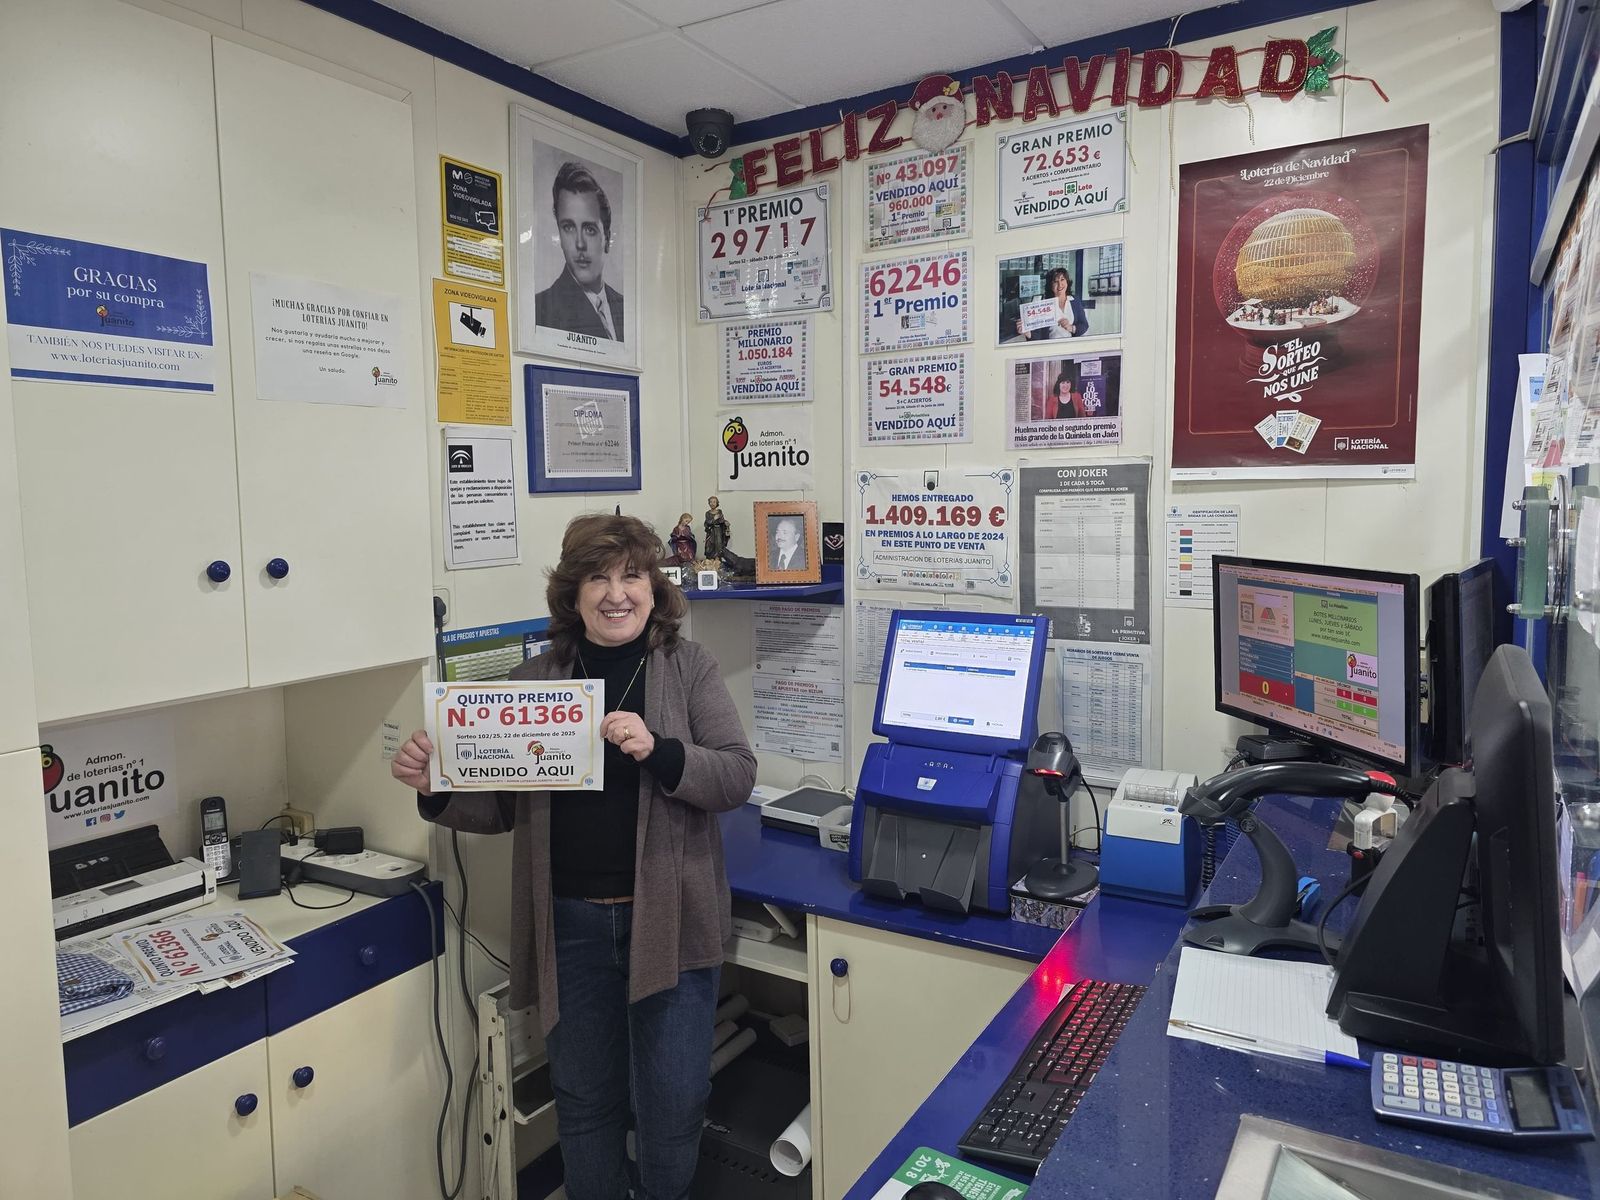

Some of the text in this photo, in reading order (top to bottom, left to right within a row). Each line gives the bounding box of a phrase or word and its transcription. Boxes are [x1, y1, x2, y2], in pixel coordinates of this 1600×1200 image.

[742, 39, 1309, 196] FELIZ NAVIDAD
[1011, 123, 1113, 154] GRAN PREMIO
[1023, 145, 1089, 173] 72.653
[1240, 149, 1357, 181] Lotería de Navidad
[895, 155, 958, 182] 43.097
[1026, 172, 1049, 181] ACIERTOS
[1054, 162, 1101, 176] COMPLEMENTARIO
[1263, 170, 1329, 187] 22 de Diciembre
[452, 184, 468, 193] ZONA
[876, 174, 959, 202] VENDIDO AQUÍ
[453, 191, 492, 208] VIDEOVIGILADA
[889, 195, 933, 213] 960.000
[1014, 198, 1070, 216] VENDIDO
[1074, 187, 1108, 206] AQUÍ
[737, 197, 803, 225] PREMIO
[901, 210, 925, 220] Premio
[74, 266, 157, 293] GRACIAS
[869, 258, 961, 297] 62246
[66, 286, 165, 309] por su compra
[444, 288, 497, 303] ZONA VIDEOVIGILADA
[894, 292, 959, 315] Premio
[272, 298, 389, 322] ¡MUCHAS GRACIAS POR CONFIAR EN
[302, 313, 368, 330] LOTERÍAS JUANITO!
[566, 333, 597, 346] JUANITO
[747, 327, 782, 338] PREMIO
[27, 334, 203, 360] TAMBIÉN NOS PUEDES VISITAR EN:
[265, 336, 287, 344] crecer,
[305, 339, 326, 349] regalas
[340, 343, 362, 351] estrellas
[377, 347, 391, 355] dejas
[361, 338, 380, 346] mejorar
[738, 336, 793, 348] MILLONARIO
[1284, 337, 1303, 351] EL
[51, 351, 180, 371] www.loteriasjuanito.com
[738, 346, 793, 361] 1.050.184
[889, 362, 957, 376] GRAN PREMIO
[1282, 366, 1297, 377] QUE
[731, 378, 800, 394] VENDIDO AQUÍ
[1263, 366, 1320, 398] NOS UNE
[573, 410, 603, 418] DIPLOMA
[875, 413, 956, 431] VENDIDO AQUÍ
[1014, 423, 1117, 434] Huelma recibe segundo premio
[1014, 433, 1028, 442] más
[1028, 433, 1049, 442] grande
[1065, 432, 1091, 440] Quiniela
[1101, 431, 1119, 439] Jaén
[1057, 468, 1108, 478] CON JOKER
[891, 494, 974, 502] HEMOS ENTREGADO
[865, 505, 1005, 527] 1.409.169 €
[877, 530, 914, 539] PREMIOS
[922, 531, 934, 539] LO
[936, 531, 966, 540] LARGO
[968, 532, 980, 540] DE
[981, 532, 1004, 541] 2024
[897, 540, 913, 548] ESTE
[914, 541, 942, 550] PUNTO
[943, 542, 956, 550] DE
[957, 542, 985, 550] VENTA
[875, 554, 923, 563] ADMINISTRACION
[933, 556, 963, 564] LOTERIAS
[457, 628, 500, 640] PRECIOS APUESTAS
[457, 692, 573, 707] QUINTO PREMIO
[499, 704, 584, 726] 61366
[85, 752, 126, 766] Admon.
[67, 763, 124, 782] de loterias
[458, 765, 574, 777] VENDIDO AQUI
[64, 795, 150, 820] www.loteriasjuanito.com
[148, 930, 189, 960] 61366
[236, 931, 267, 957] VENDIDO
[152, 953, 175, 977] QUINTO
[905, 1154, 932, 1179] 2018
